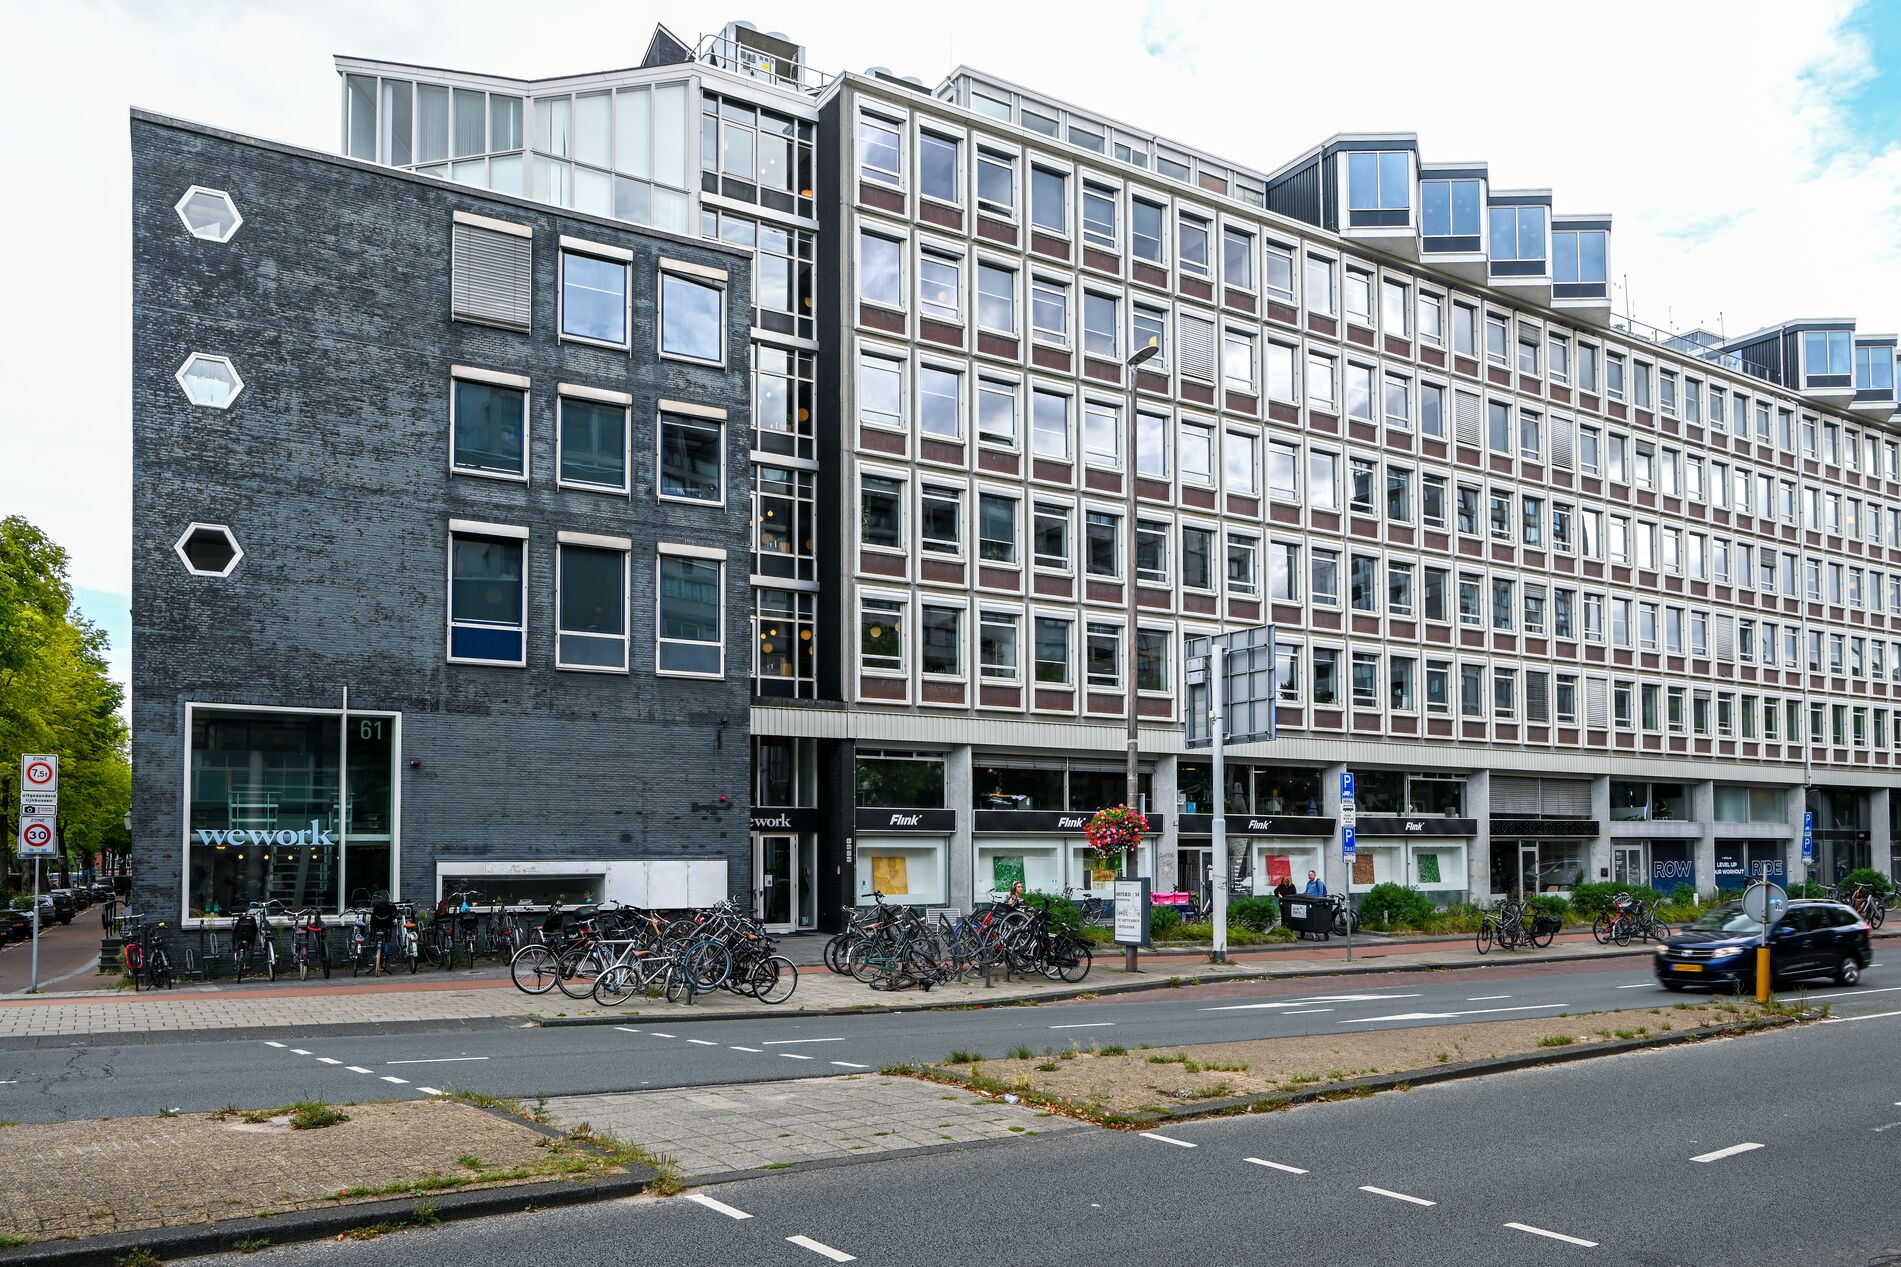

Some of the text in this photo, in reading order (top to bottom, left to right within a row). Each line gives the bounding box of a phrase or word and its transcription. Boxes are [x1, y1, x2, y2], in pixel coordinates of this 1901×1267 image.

[360, 720, 381, 740] 61
[1343, 774, 1351, 788] P
[749, 812, 792, 828] ework
[889, 813, 921, 826] Flink
[1057, 816, 1085, 828] Flink
[1248, 819, 1271, 830] Flink
[1805, 814, 1811, 824] P
[195, 818, 335, 846] wework
[1405, 821, 1424, 831] Flink
[28, 830, 47, 840] 30
[1345, 829, 1353, 843] P
[1804, 838, 1811, 849] P
[1653, 860, 1693, 879] ROW
[1751, 859, 1783, 876] RIDE
